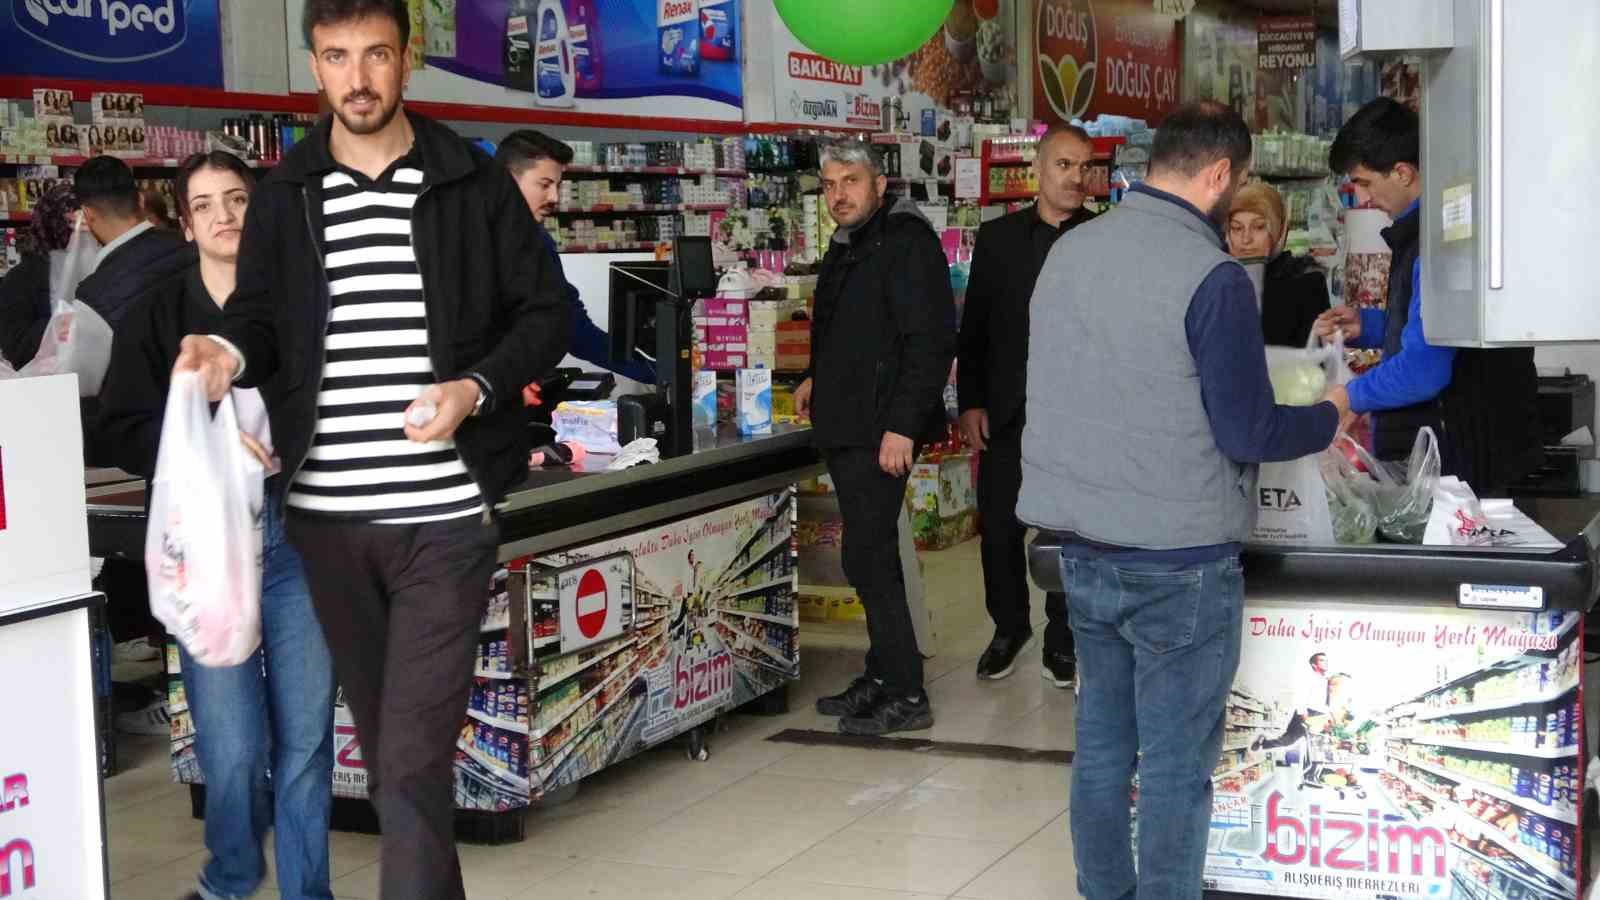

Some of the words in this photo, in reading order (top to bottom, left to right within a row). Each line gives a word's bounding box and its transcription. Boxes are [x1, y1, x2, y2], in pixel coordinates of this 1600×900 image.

[1106, 52, 1150, 109] DOĞUŞ
[1154, 65, 1177, 109] ÇAY
[1259, 52, 1315, 68] REYONU
[1249, 616, 1296, 639] Daha
[1300, 613, 1343, 647] İyisi
[1349, 620, 1426, 647] Olmayan
[1434, 624, 1476, 649] Yerli
[1482, 624, 1559, 653] Mağaza
[674, 651, 732, 709] bizim
[1263, 790, 1447, 878] bizim
